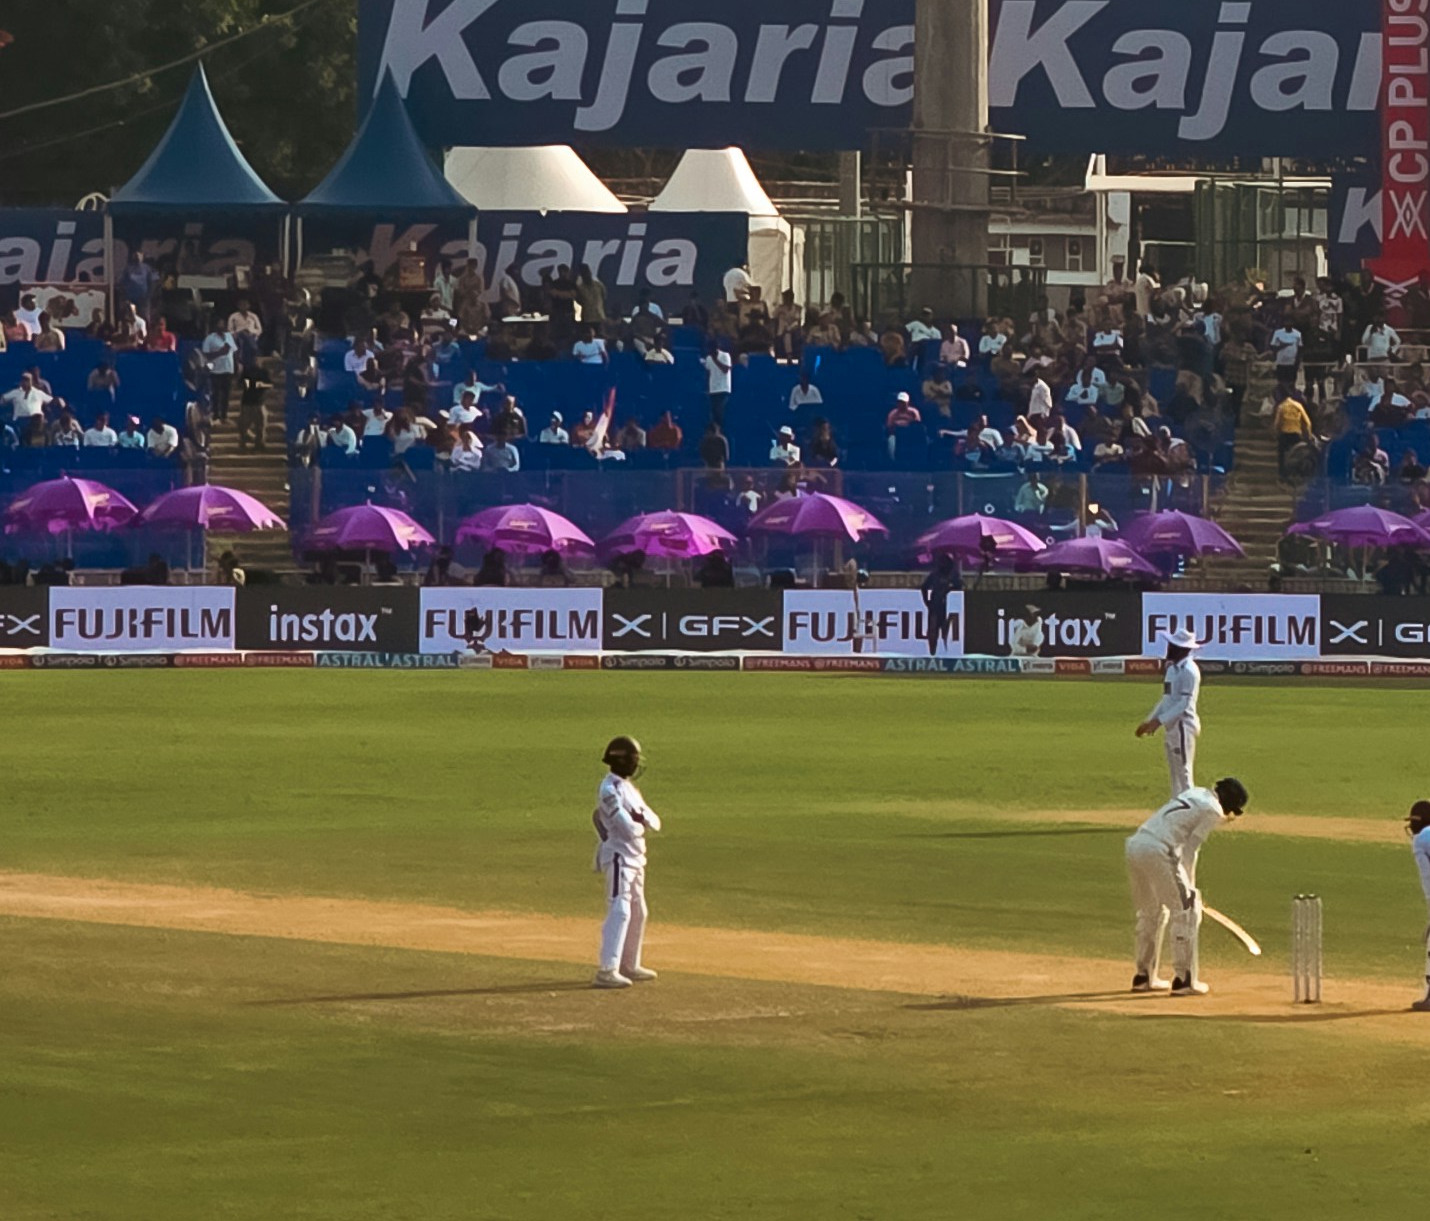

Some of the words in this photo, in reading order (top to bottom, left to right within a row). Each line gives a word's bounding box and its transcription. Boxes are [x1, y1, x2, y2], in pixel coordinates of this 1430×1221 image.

[1389, 120, 1429, 183] CP
[55, 608, 231, 640] FUJIFILM
[612, 614, 651, 637] X
[678, 615, 774, 637] GFX
[1330, 620, 1368, 644] X
[320, 654, 384, 667] ASTRAL
[391, 654, 455, 667] ASTRAL
[885, 658, 947, 671] ASTRAL
[953, 658, 1016, 671] ASTRAL
[1164, 797, 1191, 815] 7
